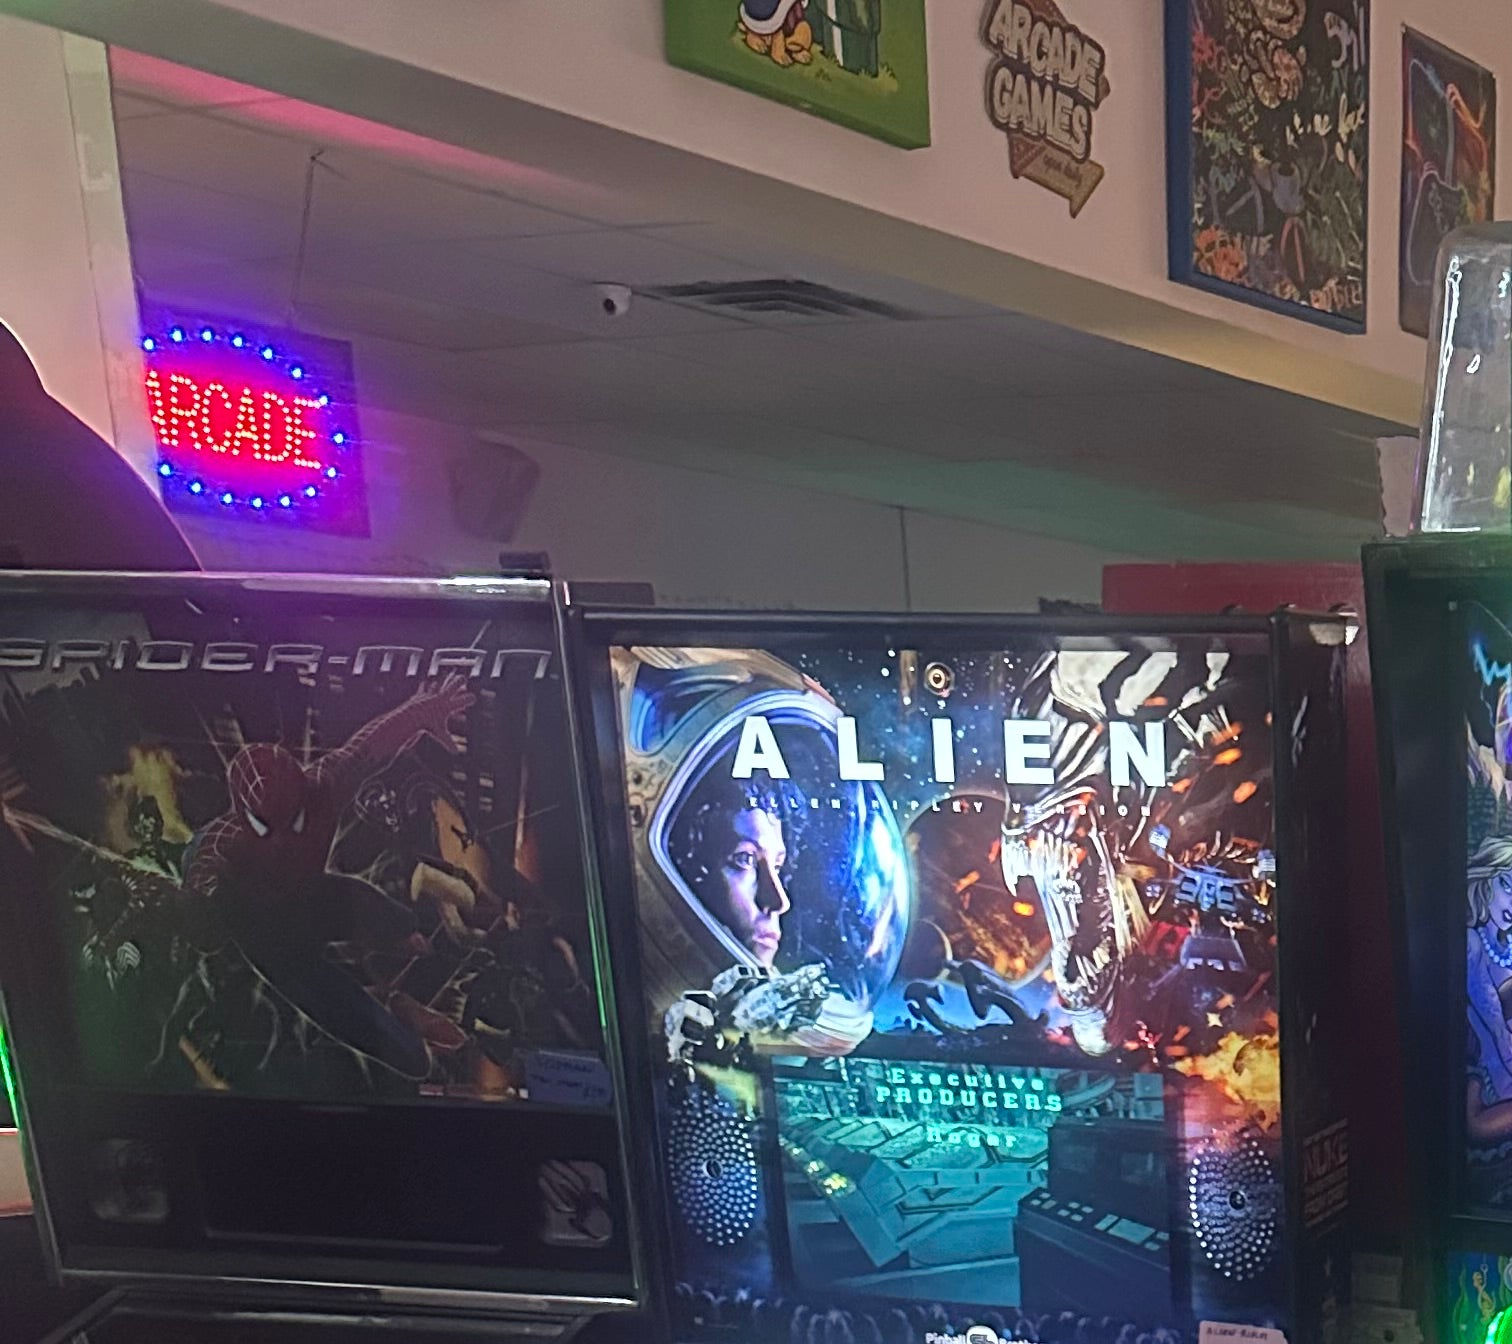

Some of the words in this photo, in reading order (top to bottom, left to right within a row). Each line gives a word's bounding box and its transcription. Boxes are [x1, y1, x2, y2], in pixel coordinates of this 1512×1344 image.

[989, 2, 1102, 102] ARCADE
[993, 67, 1090, 160] GAMES
[0, 638, 553, 681] SPIDER-MAN
[732, 715, 1167, 787] ALIEN
[876, 1086, 1062, 1112] PRODUCERS
[890, 1067, 1044, 1091] Executive
